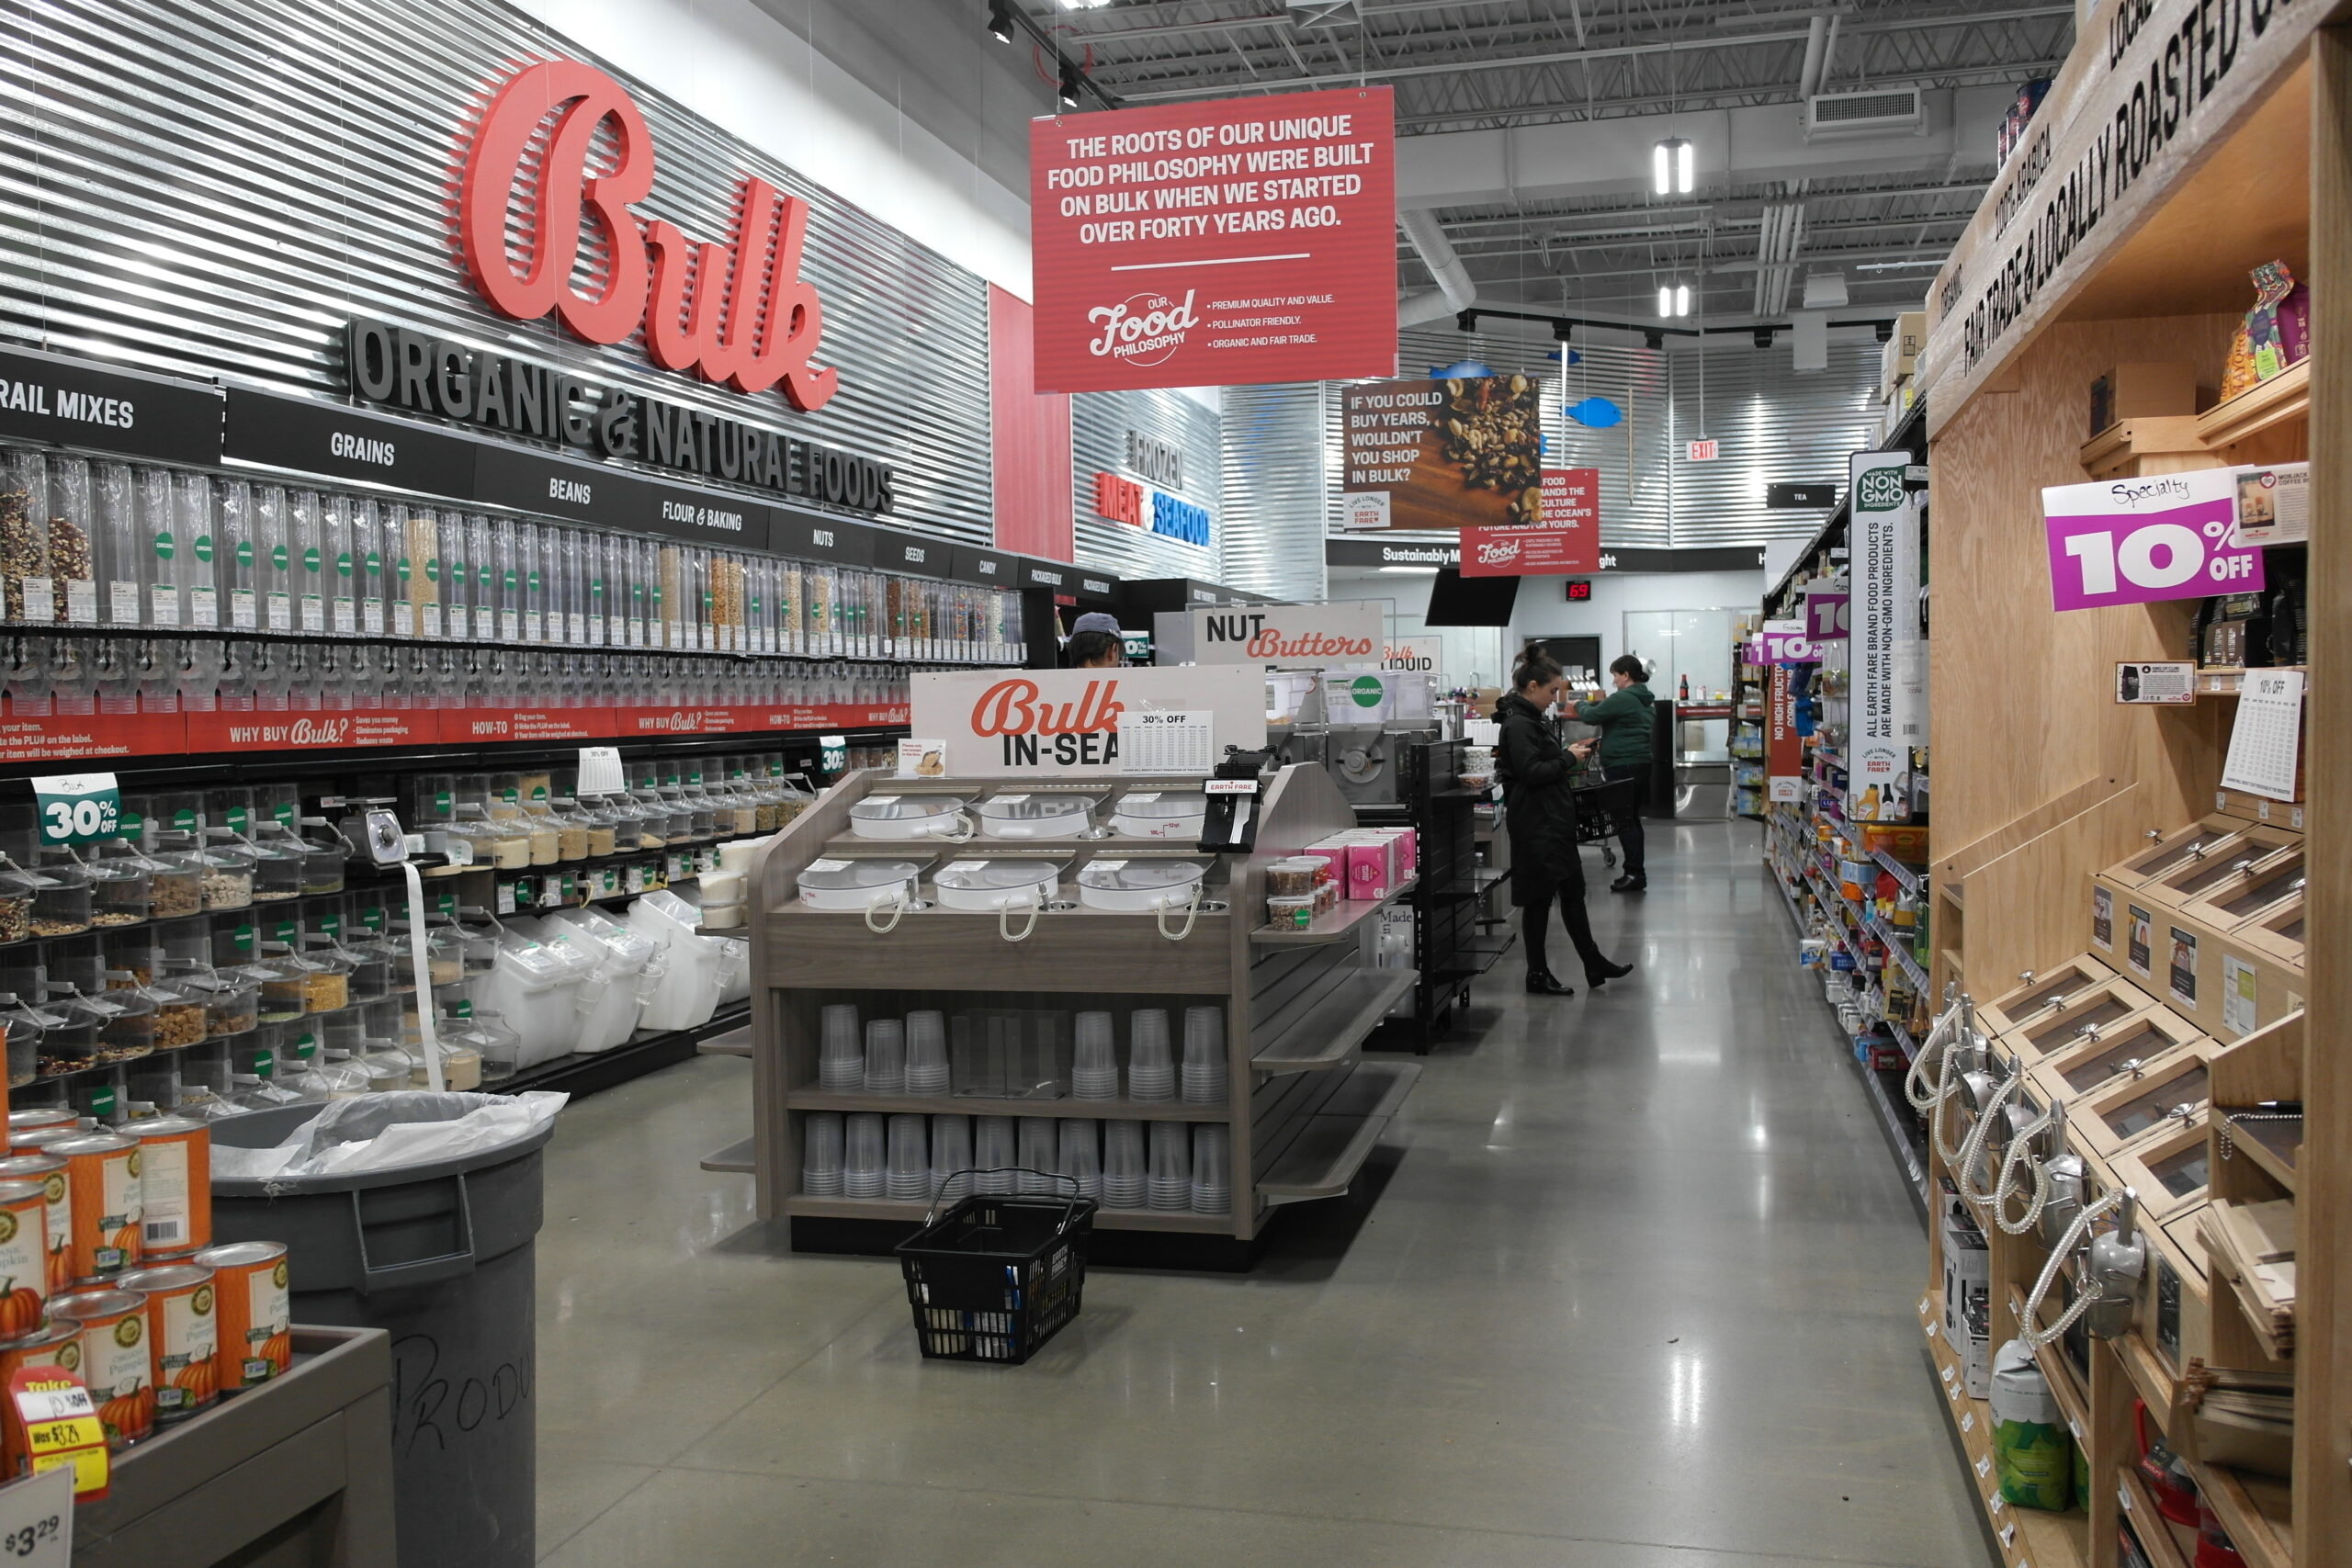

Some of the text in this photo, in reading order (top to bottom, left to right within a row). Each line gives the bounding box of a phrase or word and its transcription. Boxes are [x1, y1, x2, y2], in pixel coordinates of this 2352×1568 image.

[1067, 114, 1352, 160] THE ROOTS OF OUR UNIQUE
[1047, 142, 1374, 190] FOOD PHILOSOPHY WERE BUILT
[2017, 122, 2052, 212] ARABICA
[1060, 174, 1362, 218] ON BULK WHEN WE STARTED
[1964, 0, 2241, 378] FAIR TRADE & LOCALLY ROASTED
[1080, 205, 1341, 244] OVER FORTY YEARS AGO.
[463, 55, 838, 412] Bulk
[1148, 297, 1168, 310] OUR
[1212, 294, 1335, 311] PREMIUM QUALITY AND VALUE.
[1088, 288, 1200, 356] Food
[1213, 315, 1302, 330] POLLINATOR FRIENDLY.
[1113, 331, 1186, 358] PHILOSOPHY
[1213, 333, 1318, 349] ORGANIC AND FAIR TRADE.
[56, 389, 134, 429] MIXES
[1351, 391, 1442, 410] IF YOU COULD
[354, 318, 895, 513] ORGANIC & NATURAL FOODS
[1351, 412, 1430, 428] BUY YEARS,
[331, 432, 395, 467] GRAINS
[1351, 449, 1419, 465] YOU SHOP
[1691, 441, 1714, 459] EXIT
[1132, 431, 1183, 490] FROZEN
[1351, 468, 1411, 484] IN BULK?
[1543, 477, 1566, 486] FOOD
[1861, 474, 1902, 490] NON
[549, 478, 592, 505] BEANS
[1568, 487, 1585, 496] THE
[1793, 492, 1807, 501] TEA
[1860, 489, 1905, 502] GMO
[2110, 479, 2191, 509] Specialty
[662, 501, 742, 532] FLOUR & BAKING
[1100, 471, 1144, 527] MEAT
[1154, 491, 1210, 547] SEAFOOD
[1548, 520, 1579, 529] YOURS.
[813, 529, 834, 548] NUTS
[905, 547, 925, 564] SEEDS
[1382, 547, 1449, 565] Sustainably
[1477, 539, 1521, 564] Food
[979, 560, 997, 575] CANDY
[2209, 554, 2254, 582] OFF
[1568, 583, 1589, 598] 69
[1206, 614, 1266, 642] NUT
[1867, 522, 1879, 739] ALL EARTH FARE BRAND FOOD PRODUCTS
[1882, 522, 1894, 739] ARE MADE WITH NON-GMO INGREDIENTS.
[1246, 628, 1373, 659] Butters
[1351, 688, 1383, 696] ORGANIC
[2272, 680, 2286, 695] OFF
[970, 678, 1125, 739] Bulk
[1774, 703, 1784, 726] HIGH
[2, 722, 43, 733] your item.
[472, 721, 508, 735] HOW-TO
[639, 717, 655, 729] WHY
[656, 716, 670, 728] BUY
[670, 711, 702, 732] Bulk?
[1142, 715, 1187, 724] 30% OFF
[230, 717, 349, 745] WHY BUY Bulk?
[1774, 726, 1784, 740] NO
[9, 735, 23, 746] the
[24, 735, 46, 746] PLU#
[58, 735, 72, 744] the
[73, 734, 93, 743] label.
[6, 748, 26, 759] item
[27, 747, 40, 758] will
[41, 747, 51, 756] be
[52, 746, 85, 759] weighed
[85, 746, 93, 755] at
[94, 745, 130, 755] checkout.
[1862, 747, 1897, 760] LIVE LONGER
[100, 819, 118, 834] OFF
[120, 822, 141, 830] ORGANIC
[175, 818, 195, 827] ORGANIC
[235, 932, 253, 942] ORGANIC
[254, 1057, 273, 1068] ORGANIC
[92, 1095, 115, 1105] ORGANIC
[26, 1379, 72, 1393] Take
[32, 1430, 51, 1445] Was
